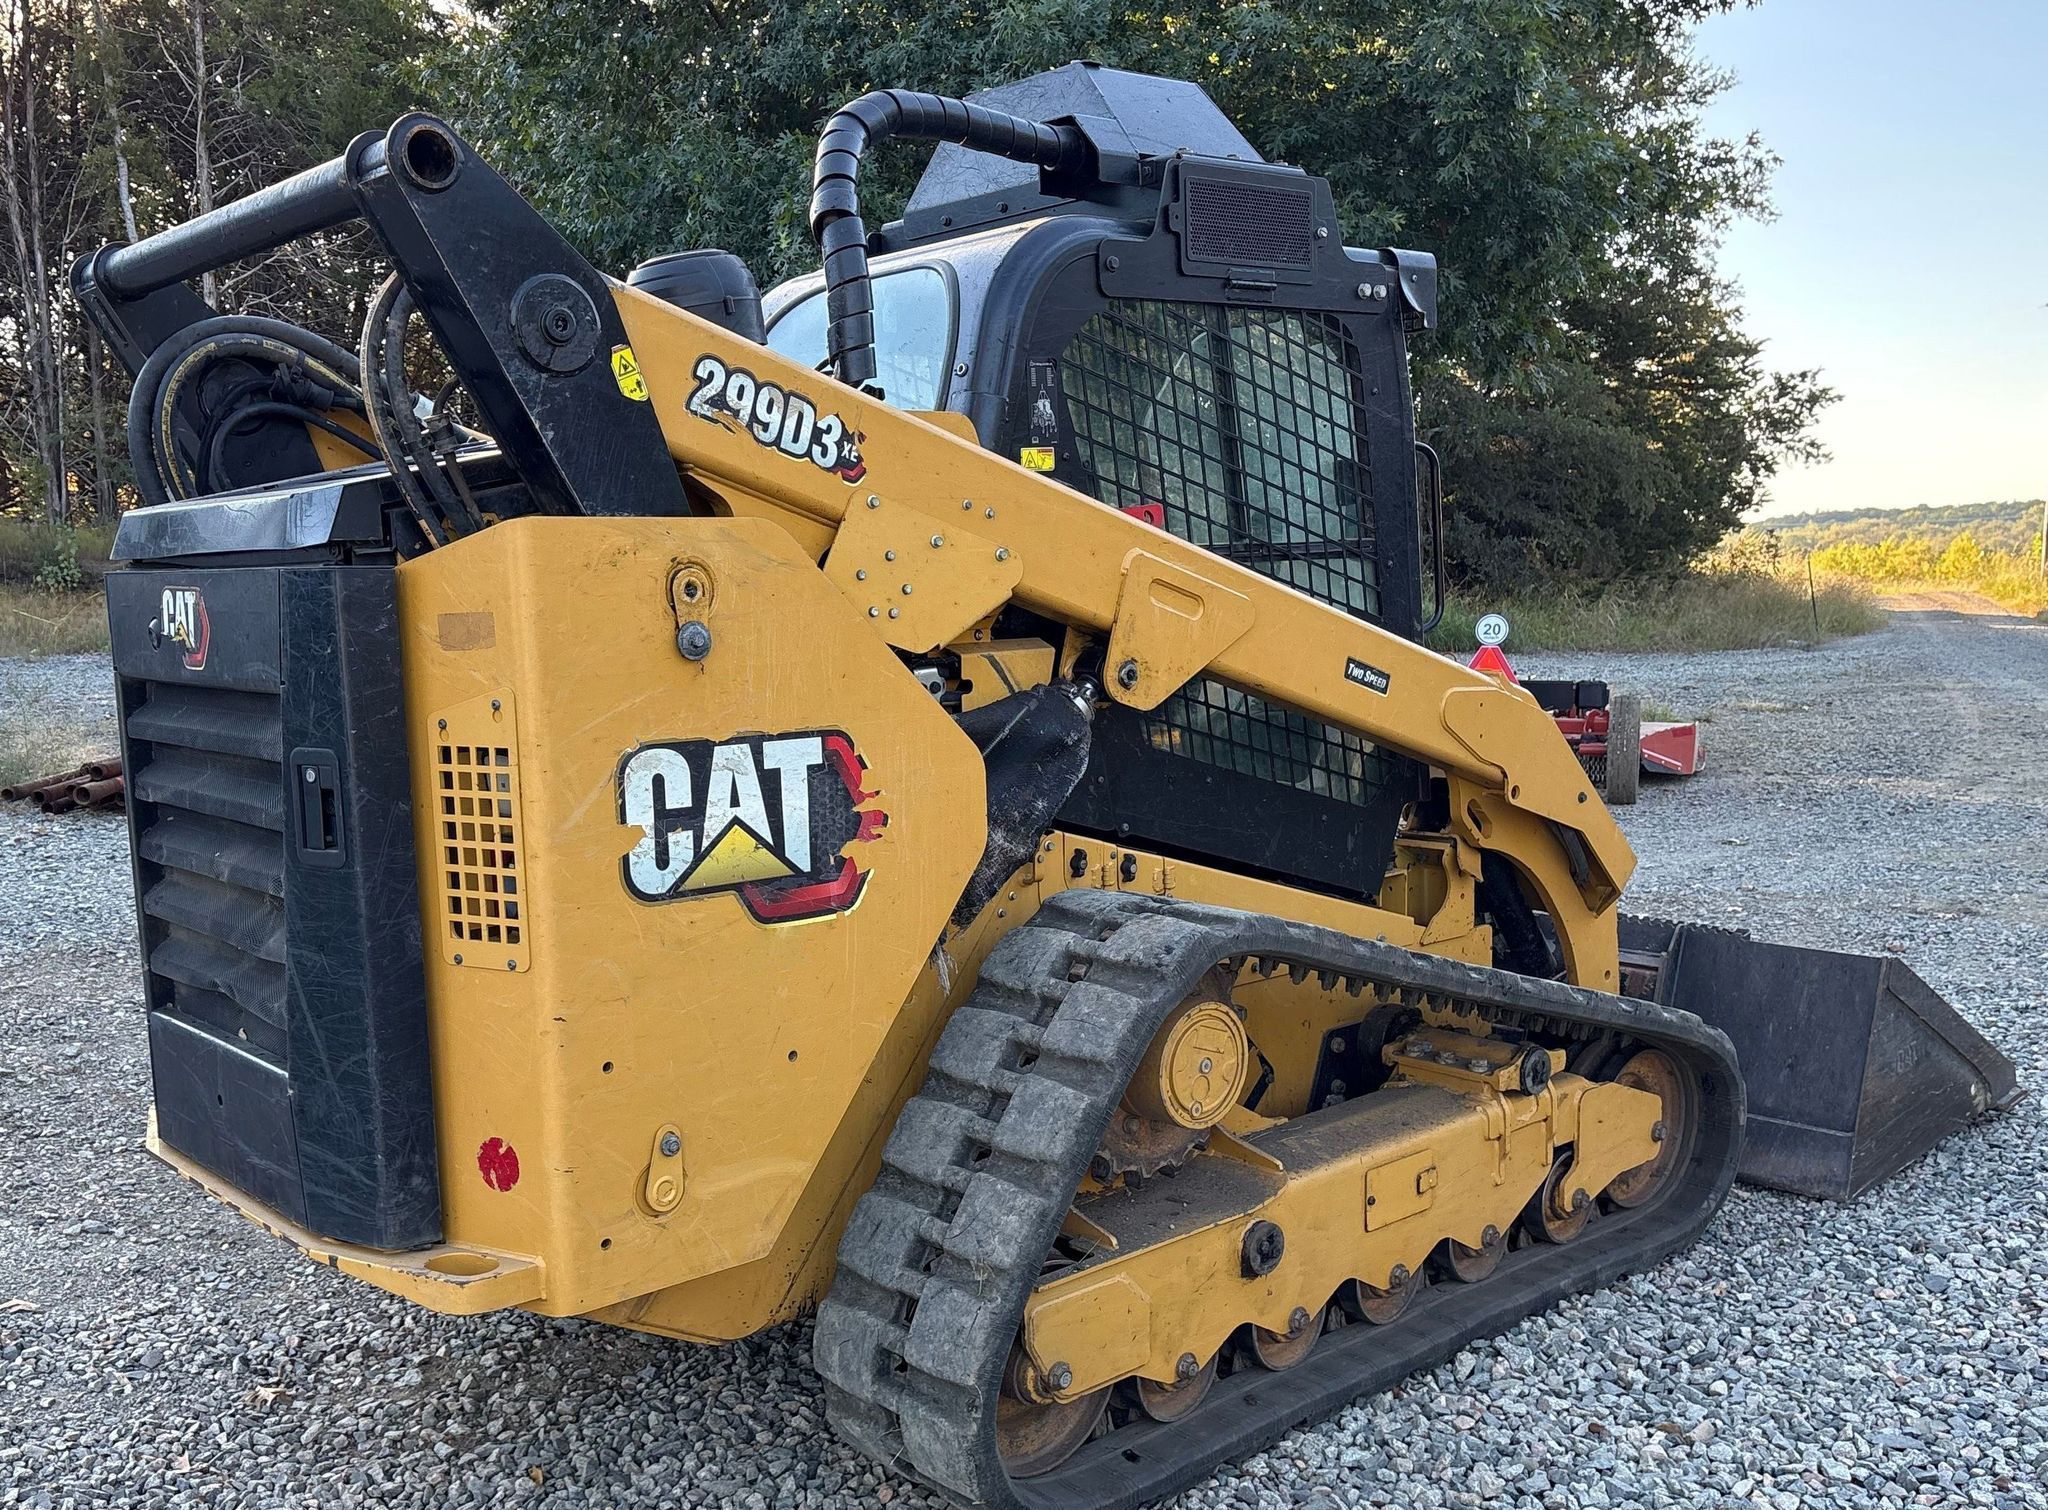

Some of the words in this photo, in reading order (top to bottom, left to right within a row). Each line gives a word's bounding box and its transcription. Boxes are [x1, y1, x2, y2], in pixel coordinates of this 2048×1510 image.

[689, 358, 842, 469] 299D3
[162, 589, 196, 648] CAT
[1483, 623, 1501, 636] 20
[623, 737, 823, 894] CAT
